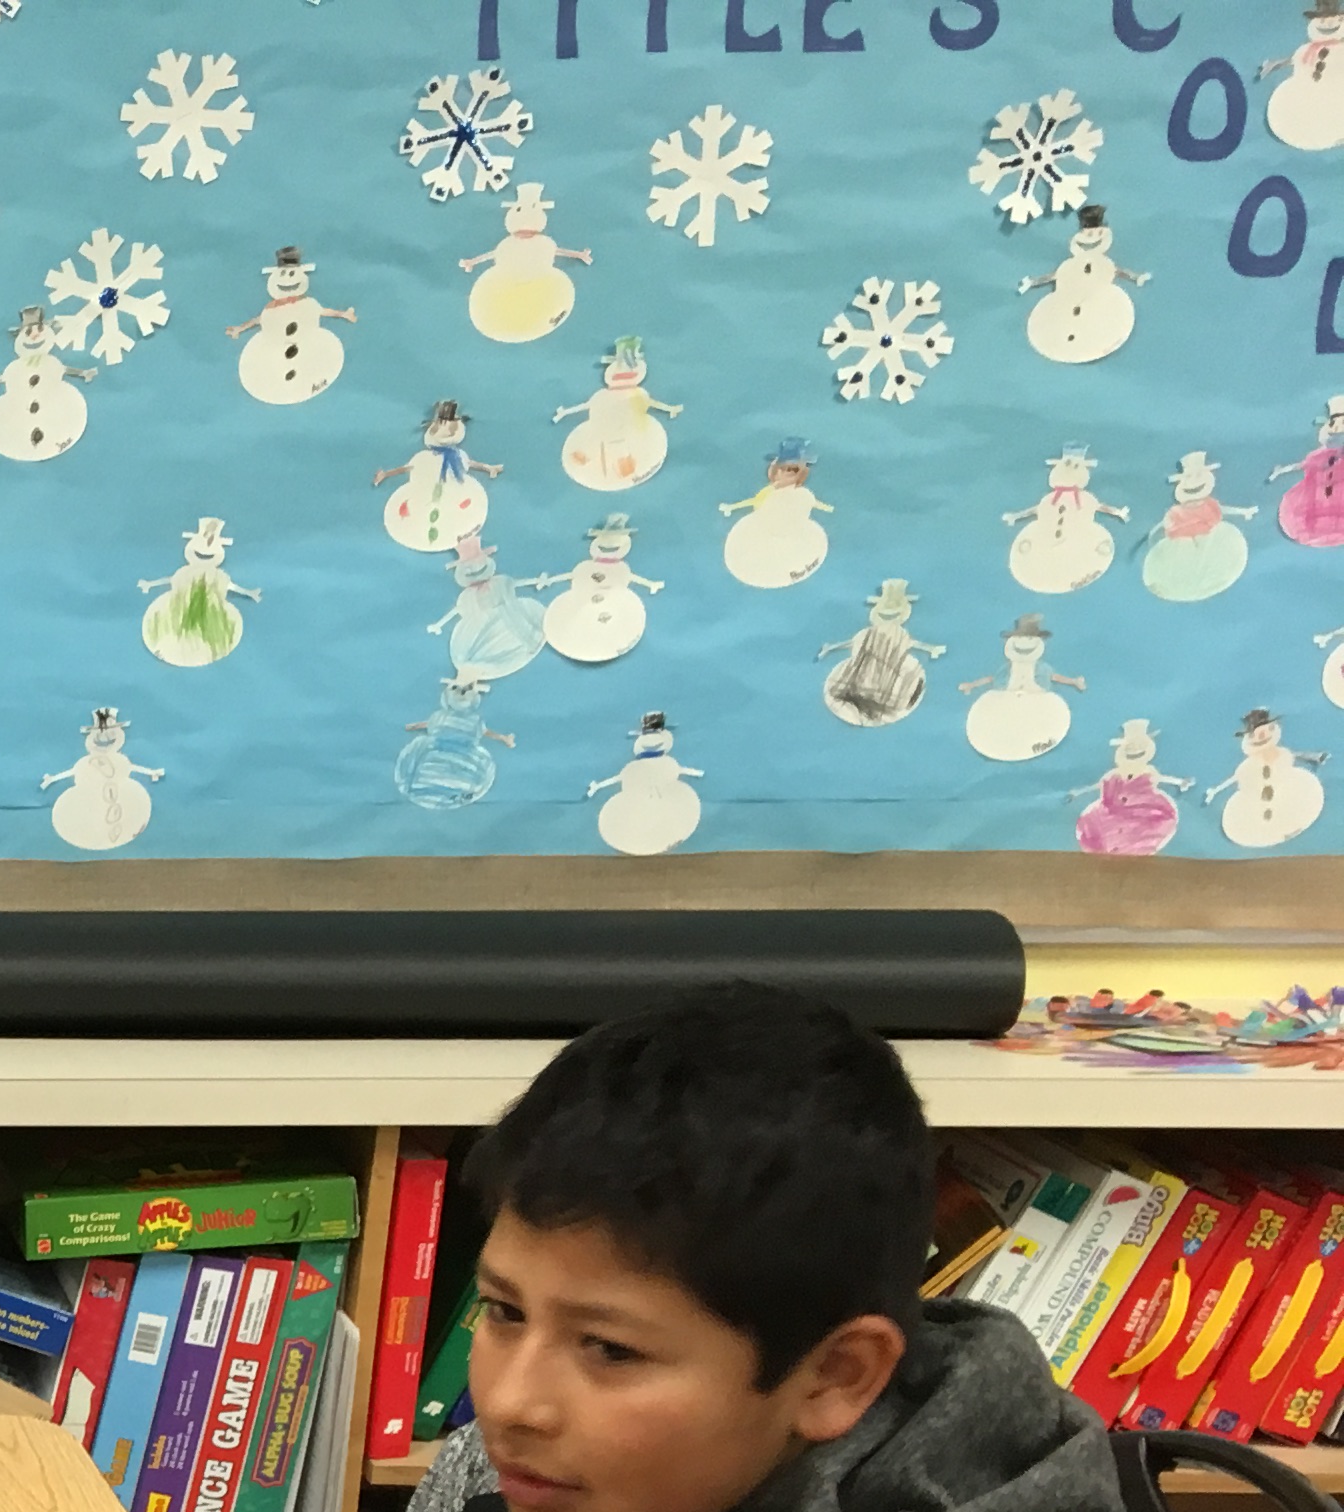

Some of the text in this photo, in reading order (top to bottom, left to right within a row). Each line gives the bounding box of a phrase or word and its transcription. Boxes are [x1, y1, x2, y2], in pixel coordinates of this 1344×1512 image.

[59, 1232, 131, 1247] Comparisons!
[68, 1211, 121, 1224] The Game
[73, 1222, 116, 1235] of Crazy
[1121, 1185, 1171, 1247] Bingo
[1045, 1209, 1114, 1312] COMPOUND
[1049, 1281, 1112, 1371] Alphabet
[212, 1358, 260, 1450] GAME
